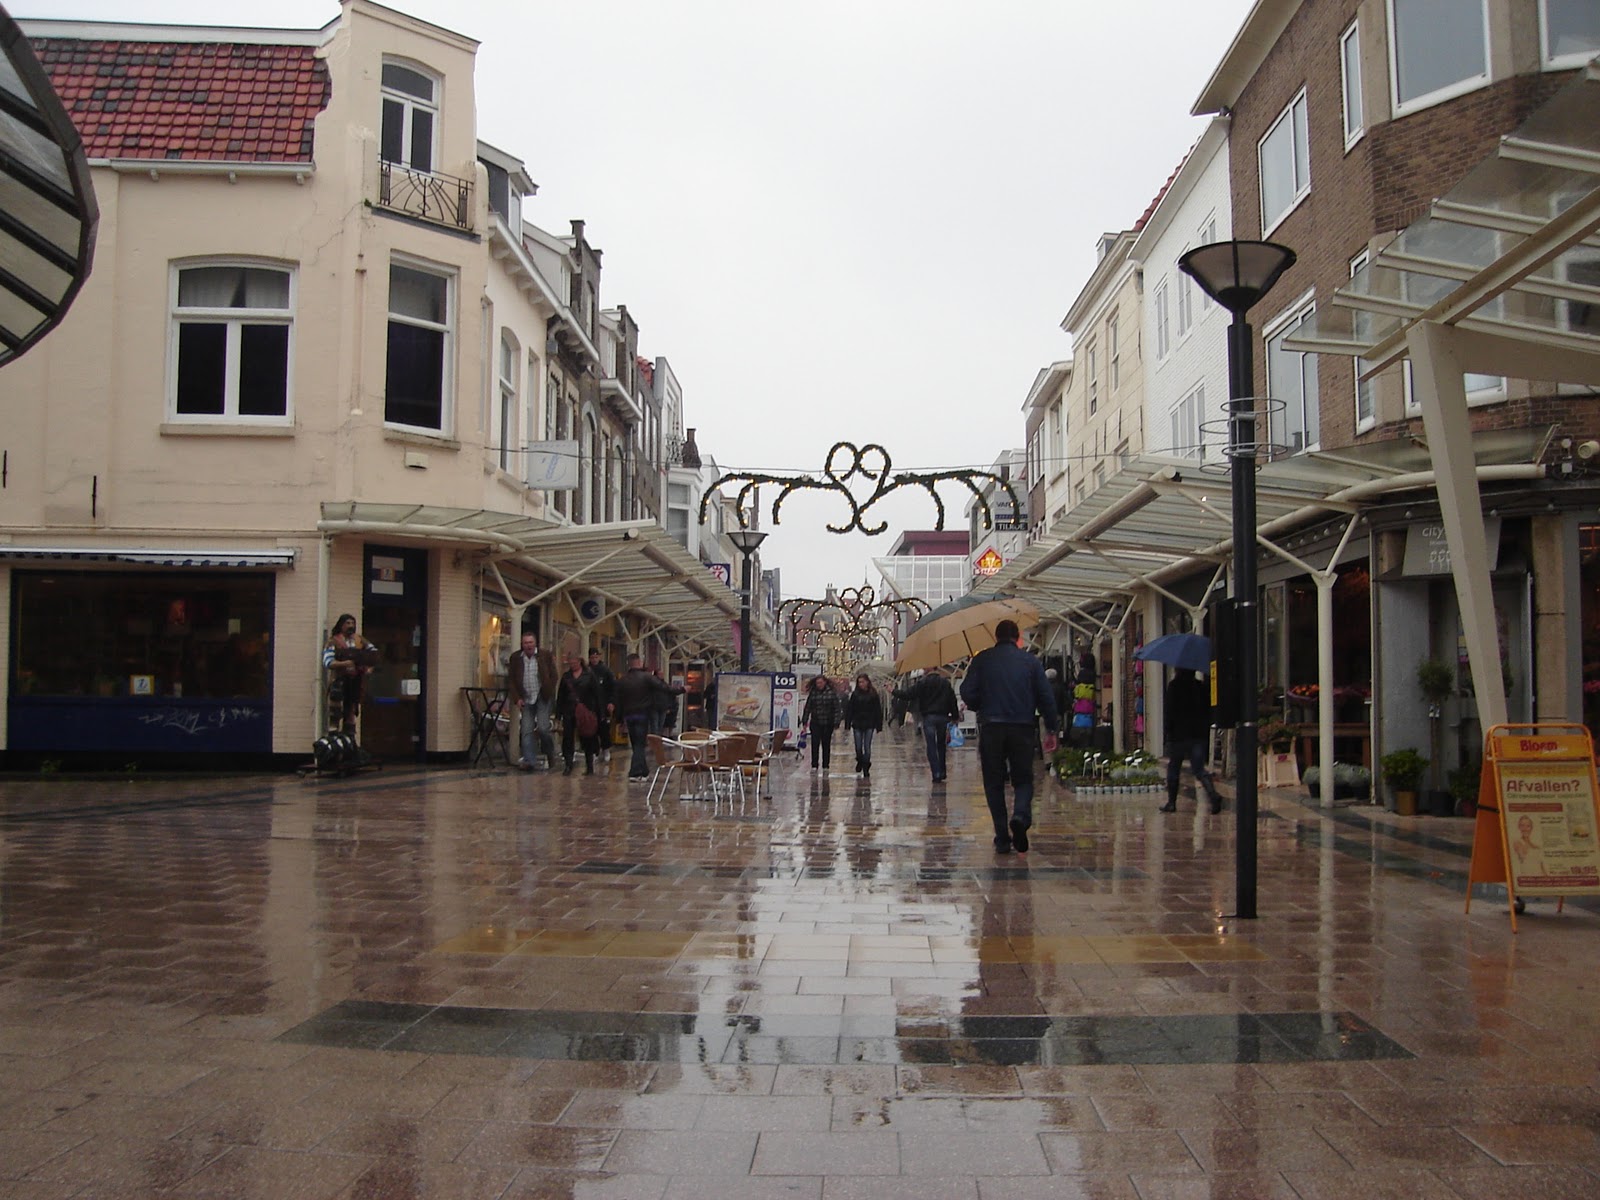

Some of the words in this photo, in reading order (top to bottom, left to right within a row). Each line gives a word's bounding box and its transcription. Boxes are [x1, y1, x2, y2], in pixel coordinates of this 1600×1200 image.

[1422, 524, 1444, 540] city
[774, 675, 796, 686] tos
[1520, 740, 1558, 752] Bloem
[1506, 779, 1580, 792] Afvallen?
